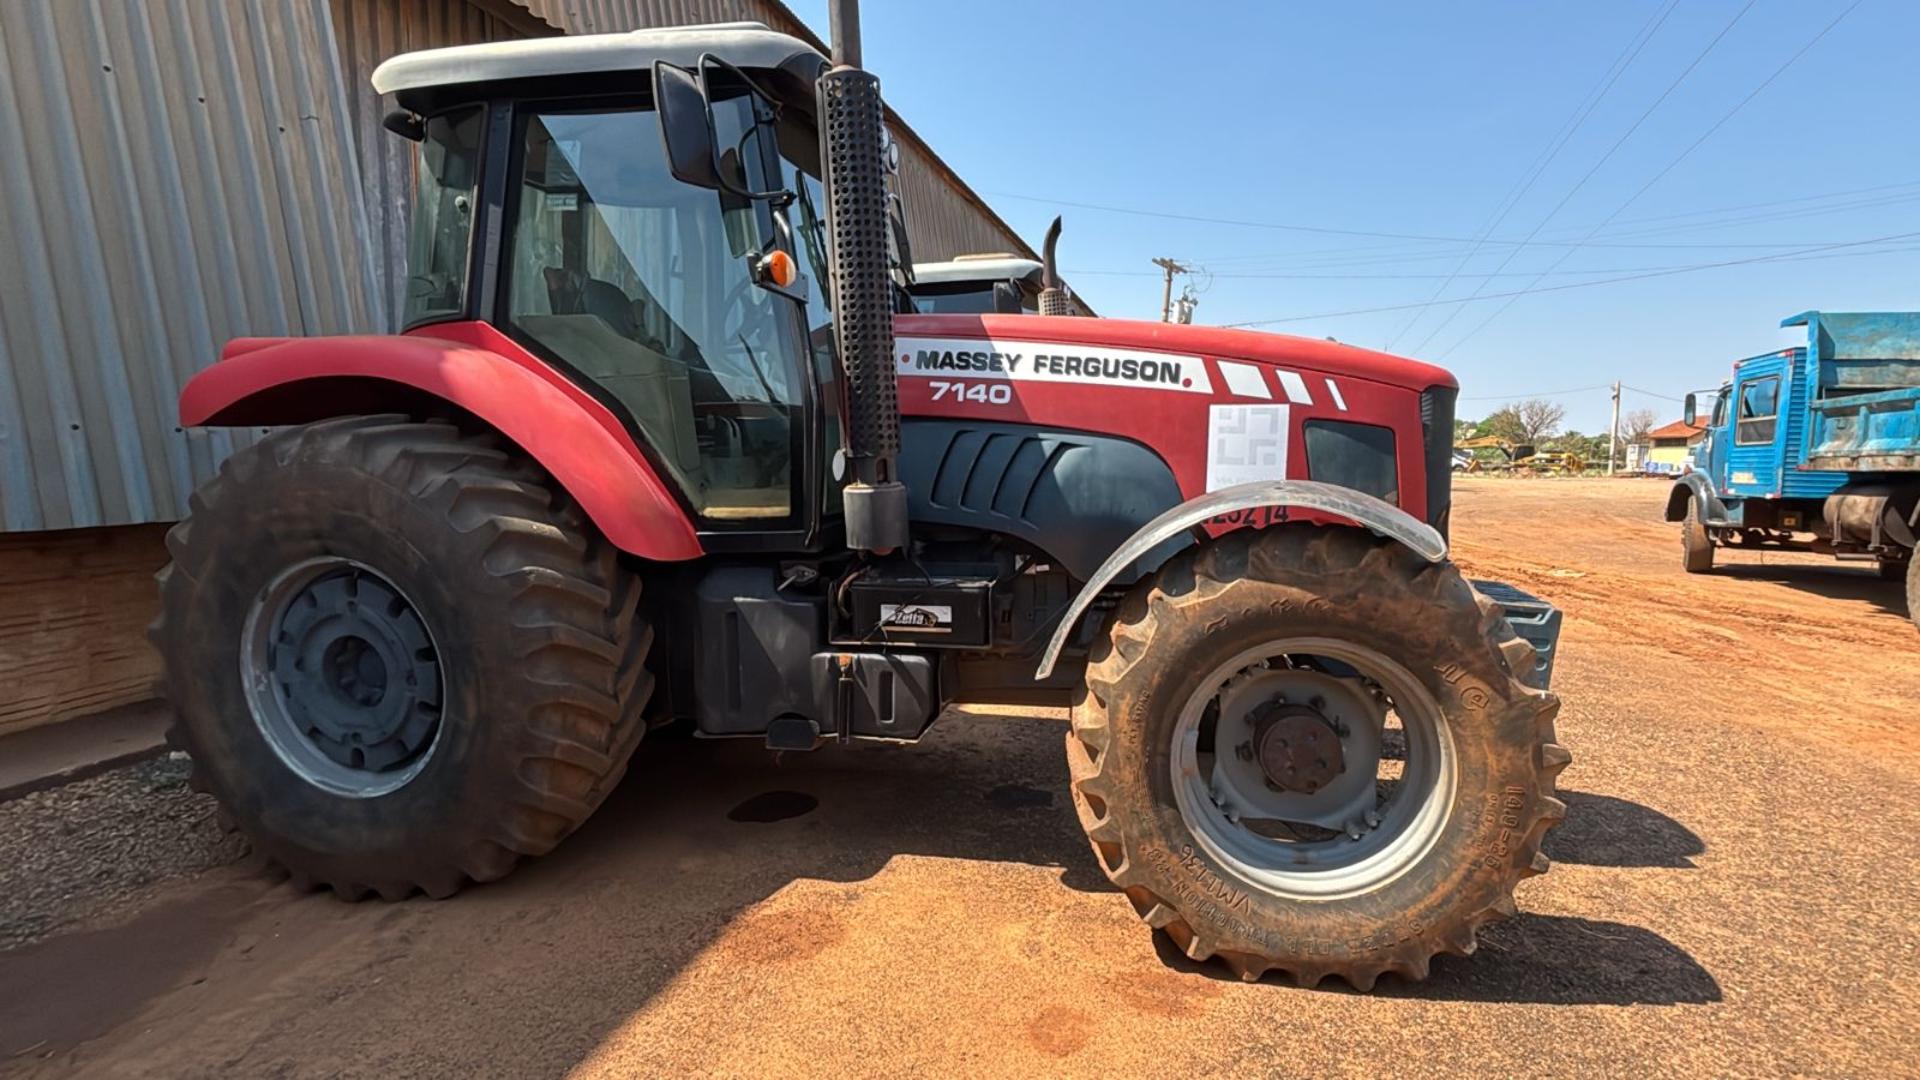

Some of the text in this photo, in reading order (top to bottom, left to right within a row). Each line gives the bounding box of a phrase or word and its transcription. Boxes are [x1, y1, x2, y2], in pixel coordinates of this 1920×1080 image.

[915, 350, 1181, 385] MASSEY FERGUSON
[929, 381, 1012, 404] 7140
